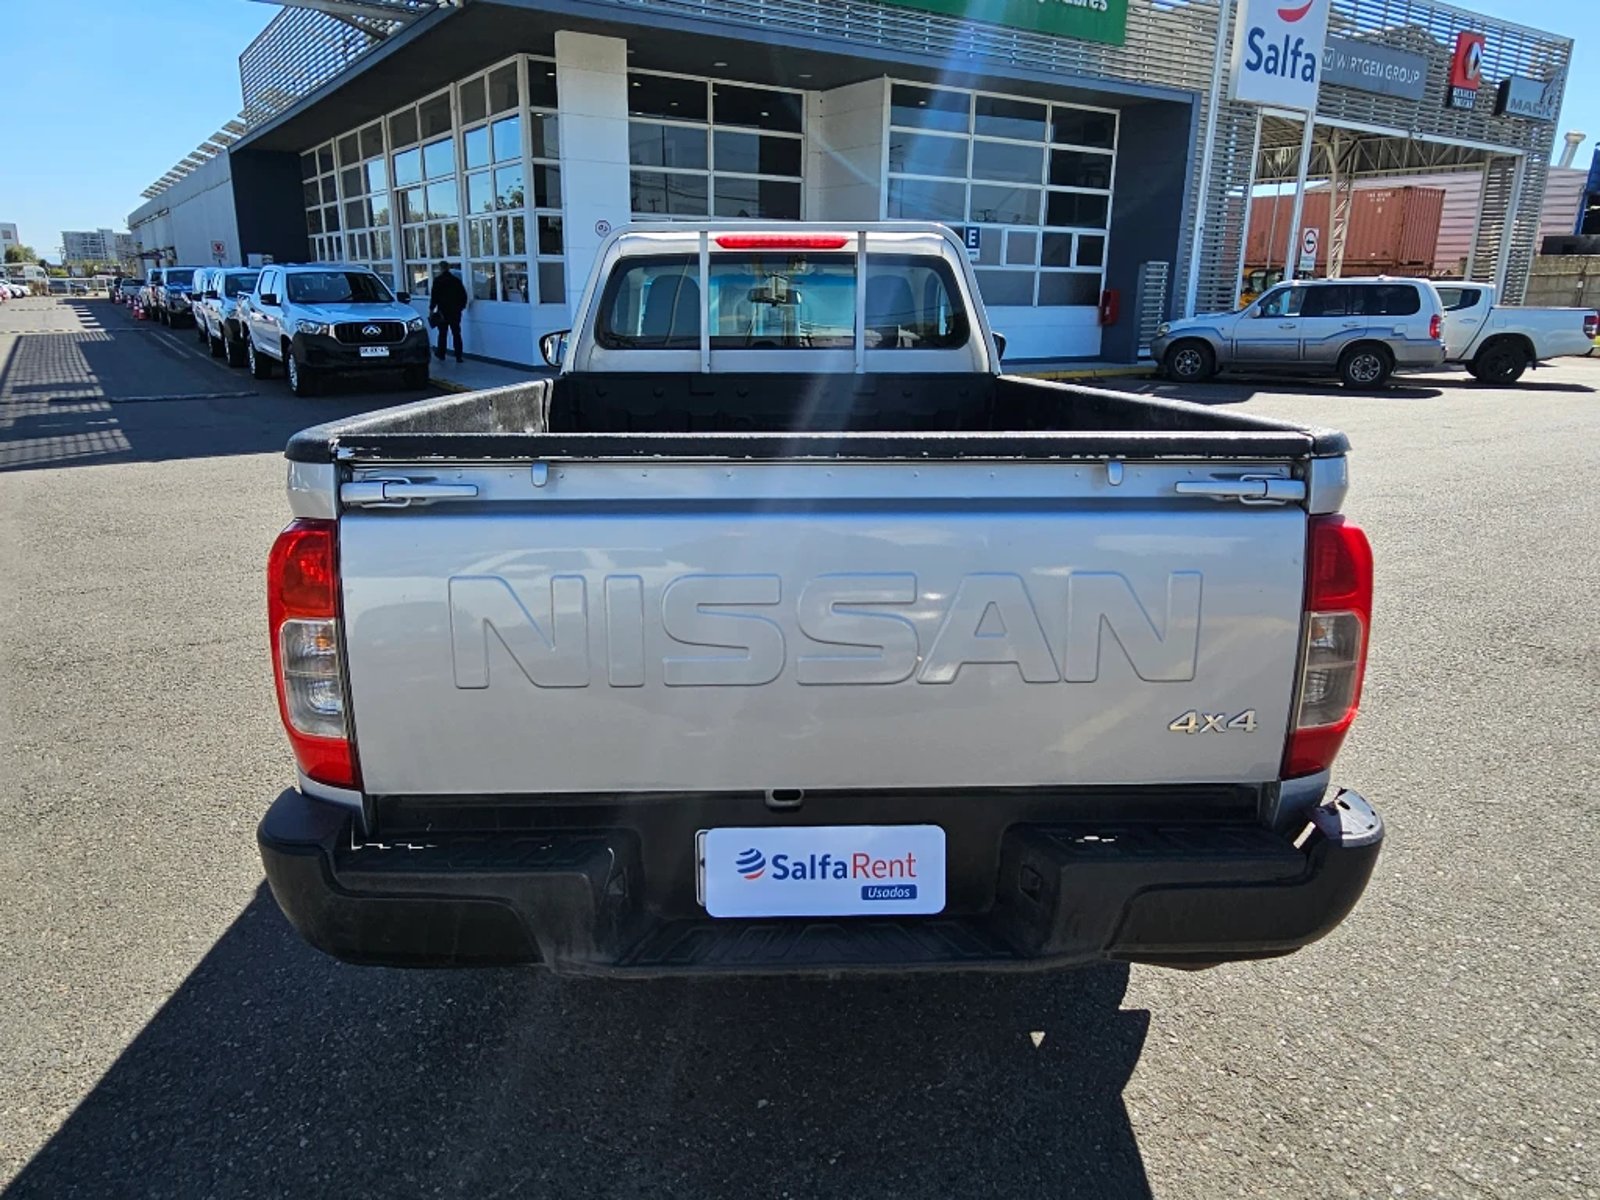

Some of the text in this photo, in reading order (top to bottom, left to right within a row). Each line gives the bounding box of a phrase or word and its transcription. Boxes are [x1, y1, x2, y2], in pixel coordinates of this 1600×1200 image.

[1245, 26, 1317, 83] Salfa
[1336, 53, 1384, 77] WIRTGEN
[1385, 63, 1421, 84] GROUP
[968, 229, 978, 246] E
[448, 570, 1204, 689] NISSAN
[1167, 708, 1259, 736] 4x4
[771, 852, 918, 881] SalfaRent
[867, 886, 911, 899] Usados
